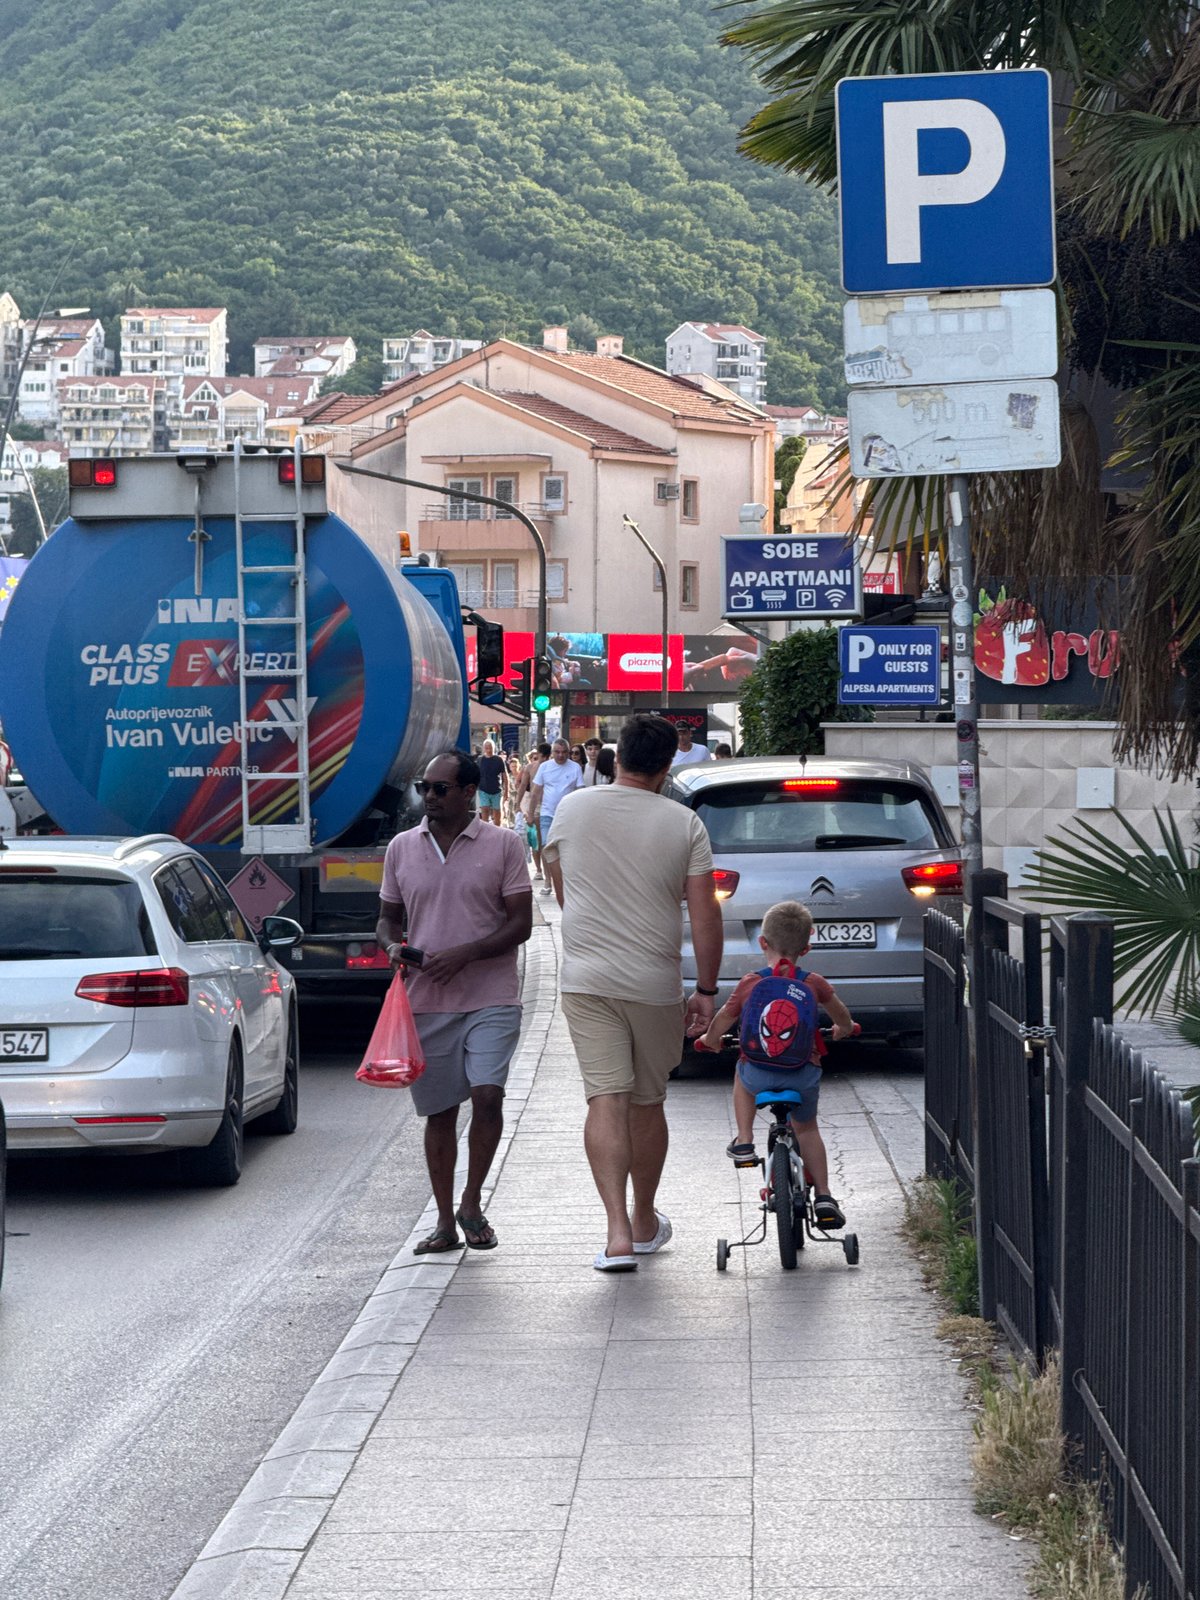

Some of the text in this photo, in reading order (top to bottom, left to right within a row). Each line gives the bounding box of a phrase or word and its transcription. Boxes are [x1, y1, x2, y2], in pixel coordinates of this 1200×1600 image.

[883, 98, 1006, 264] P
[762, 542, 818, 559] SOBE
[729, 569, 851, 587] APARTMANI
[80, 643, 171, 665] CLASS
[848, 635, 875, 673] P
[878, 644, 932, 655] ONLY FOR
[186, 646, 298, 680] EXPERT
[884, 661, 929, 673] GUESTS
[89, 664, 160, 686] PLUS
[843, 684, 935, 693] ALPESA APARTMENTS
[105, 705, 212, 722] Autoprijevoznik
[106, 718, 273, 747] Ivan Vuletić
[206, 765, 260, 777] PARTNER
[817, 924, 873, 941] KC323
[3, 1033, 44, 1054] 547
